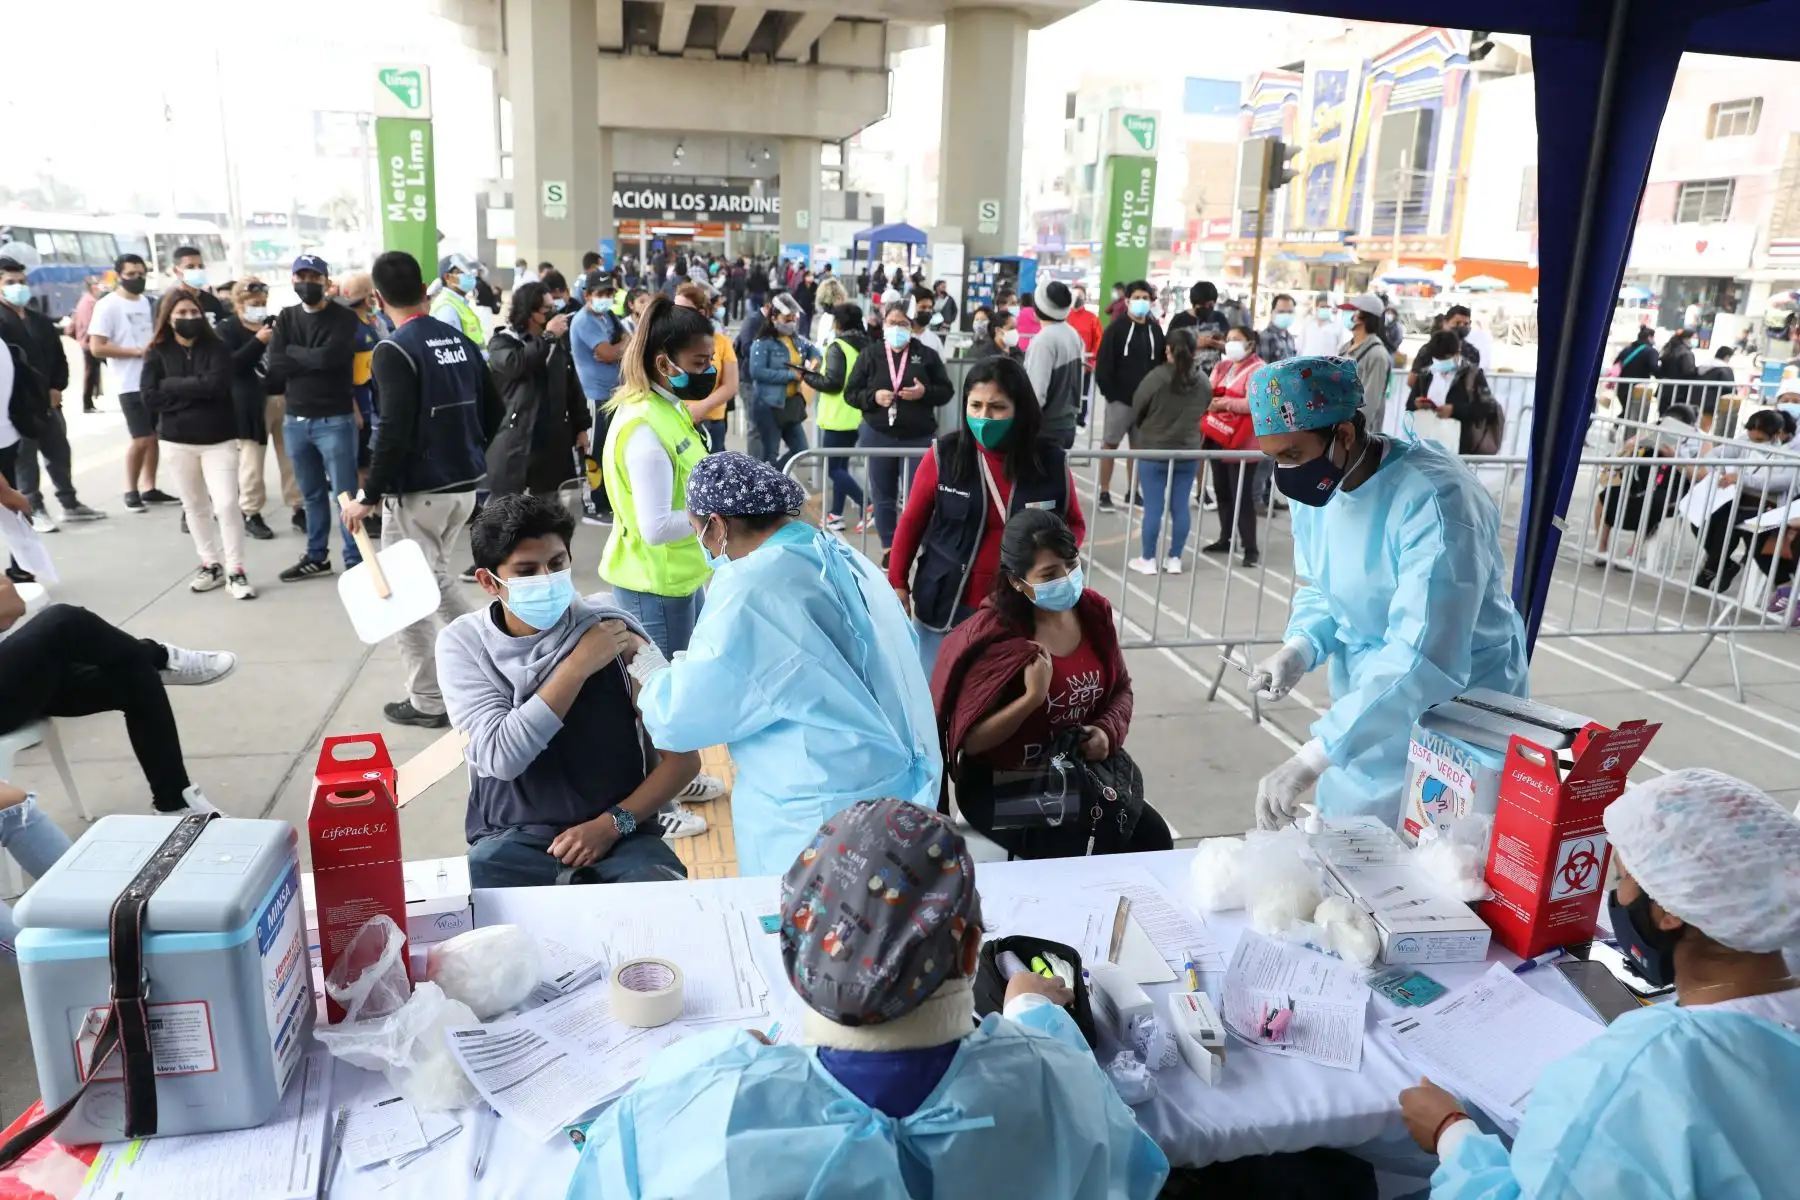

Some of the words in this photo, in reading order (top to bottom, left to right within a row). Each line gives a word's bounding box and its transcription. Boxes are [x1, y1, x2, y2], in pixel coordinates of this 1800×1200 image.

[408, 88, 418, 107] 1
[406, 129, 426, 186] Lima
[388, 156, 407, 222] Metro
[547, 184, 563, 202] S
[612, 189, 666, 210] ACIÓN
[672, 194, 705, 212] LOS
[708, 194, 780, 214] JARDINE
[1133, 167, 1151, 216] Lima
[407, 194, 427, 222] de
[982, 202, 996, 219] S
[1115, 190, 1134, 248] Metro
[1131, 223, 1147, 248] de
[434, 345, 467, 365] Salud
[1411, 740, 1432, 764] OSTA
[1437, 759, 1467, 788] VERDE
[1423, 728, 1474, 775] MINSA
[1511, 769, 1544, 793] LifePack
[321, 822, 372, 841] LifePack
[267, 883, 291, 931] MINSA
